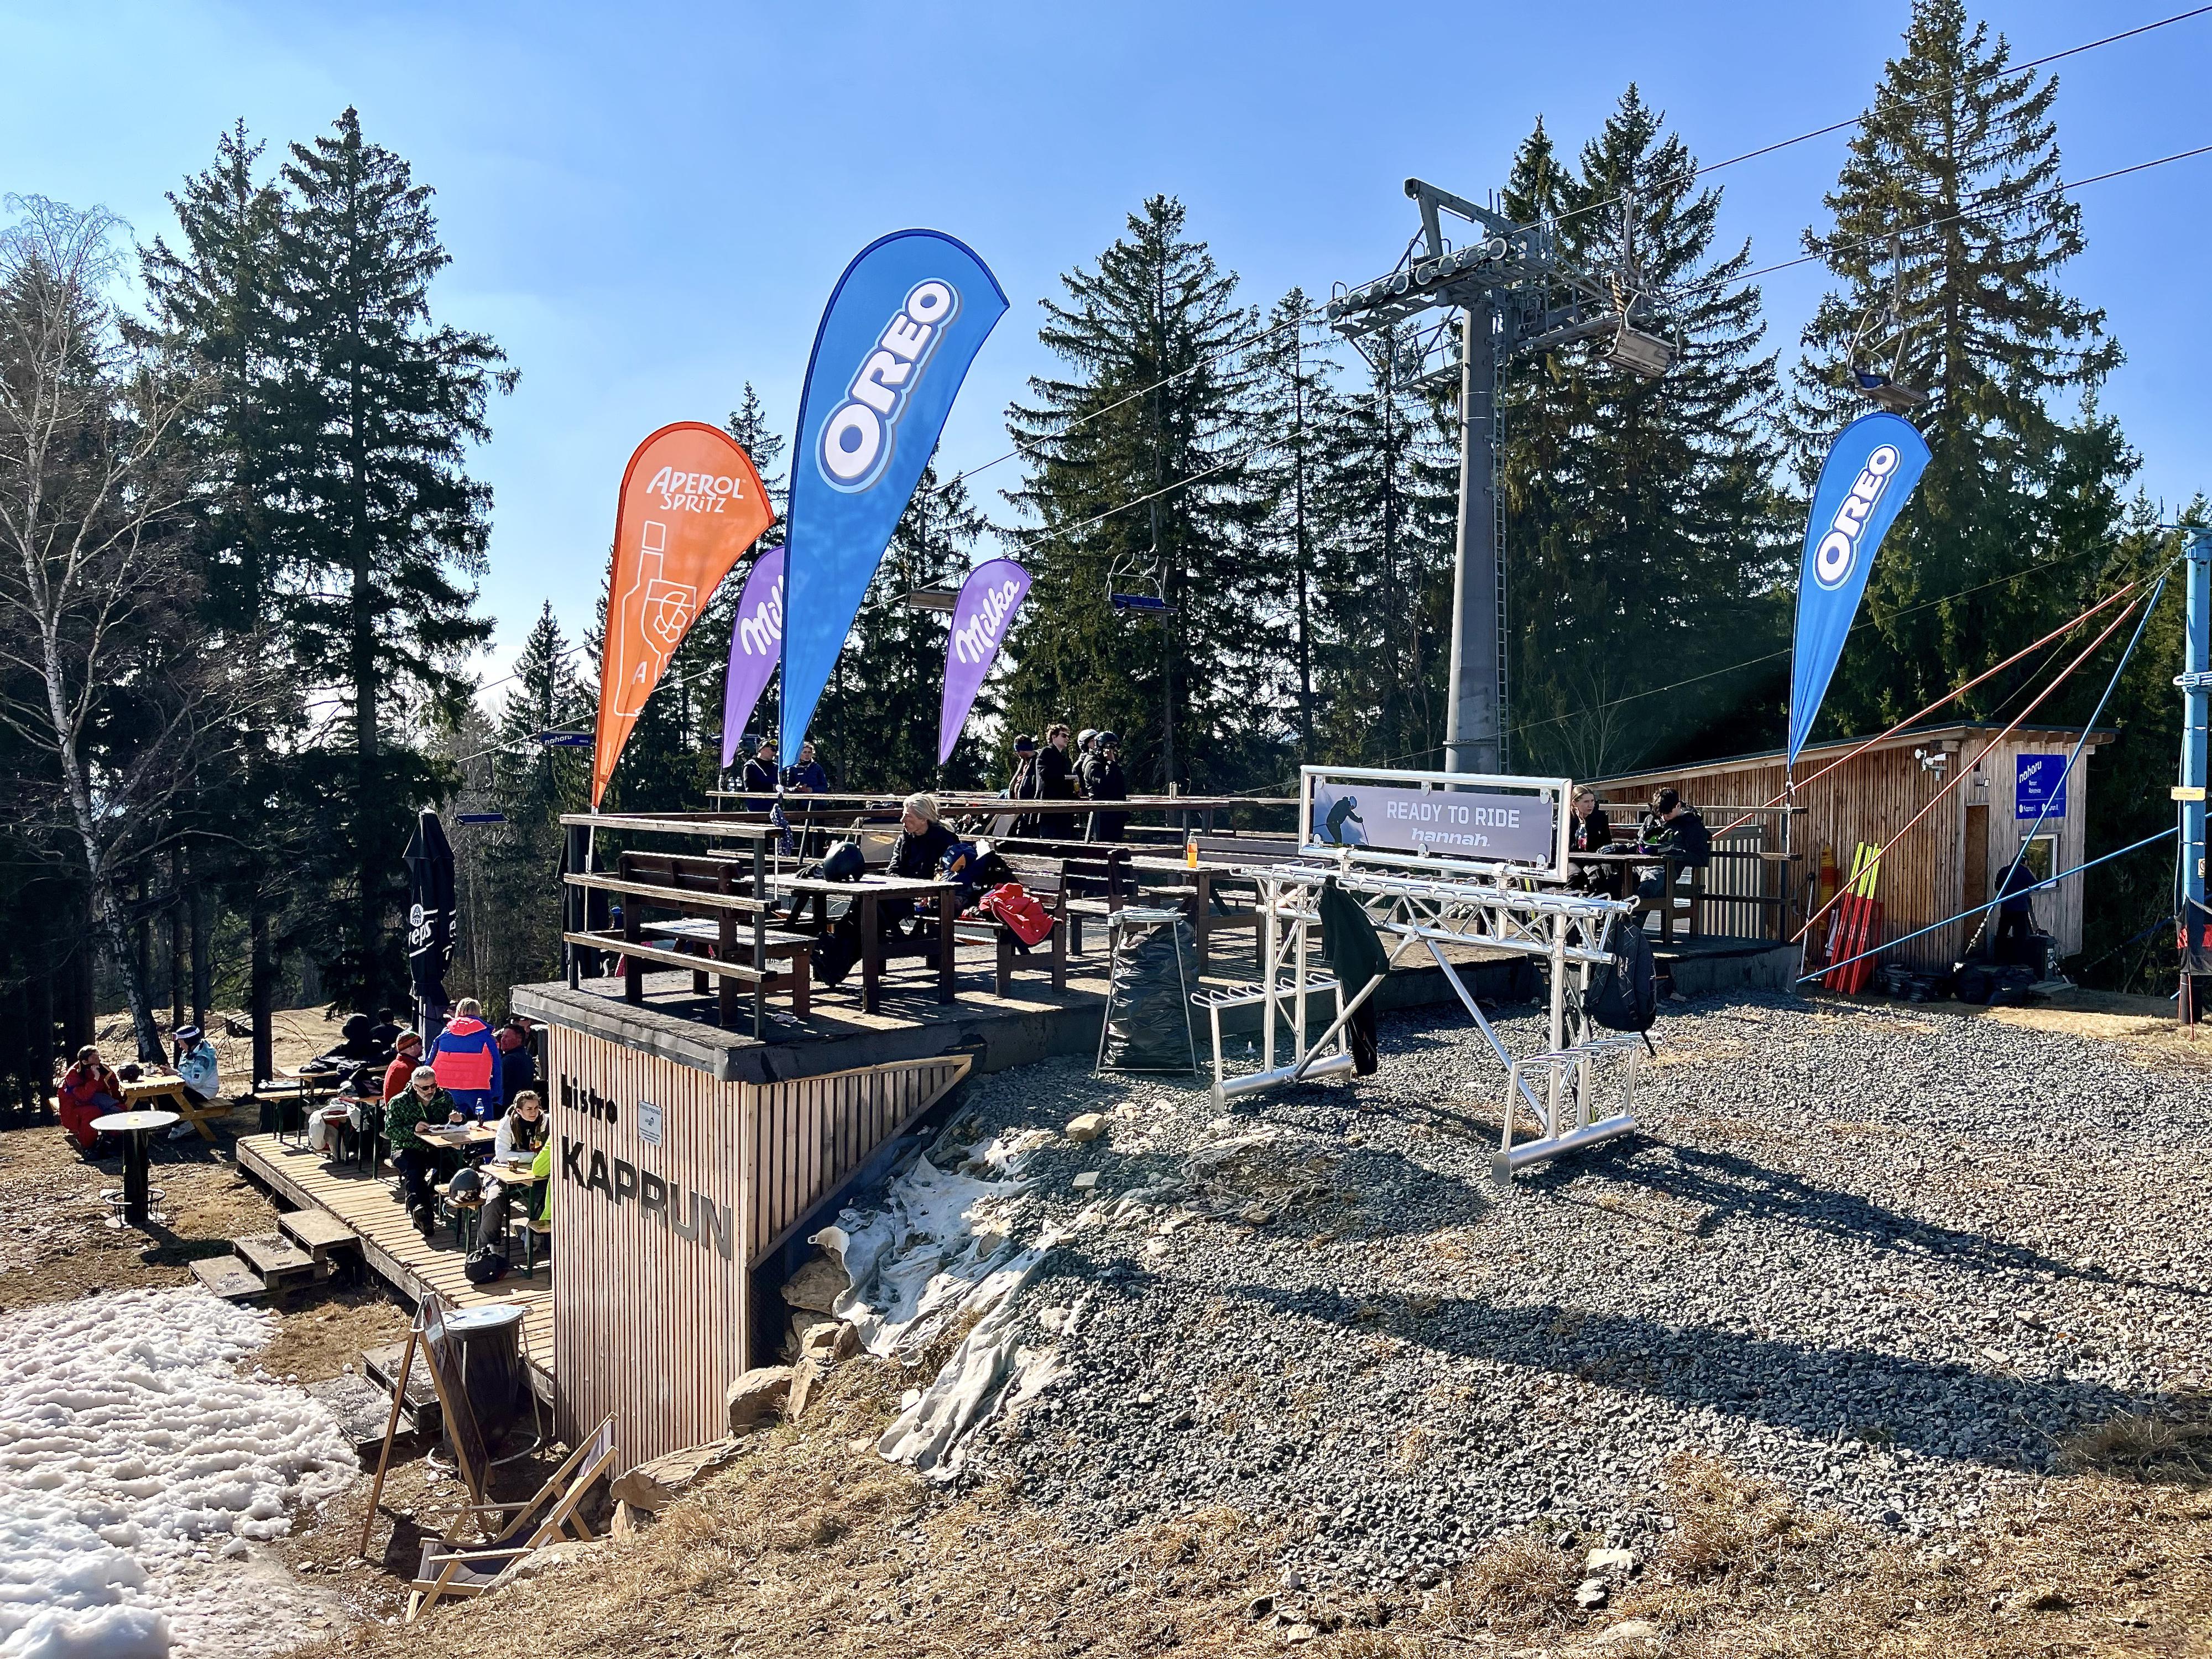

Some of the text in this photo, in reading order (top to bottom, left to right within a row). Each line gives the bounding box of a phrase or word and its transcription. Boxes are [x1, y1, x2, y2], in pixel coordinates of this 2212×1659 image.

[825, 282, 951, 478] OREO
[646, 466, 744, 499] APEROL
[1818, 447, 1896, 582] OREO
[741, 575, 784, 655] Mil
[955, 580, 1020, 664] Milka
[633, 661, 648, 685] A
[1386, 800, 1520, 829] READY TO RIDE
[561, 1072, 617, 1125] bistro
[562, 1135, 732, 1261] KAPRUN
